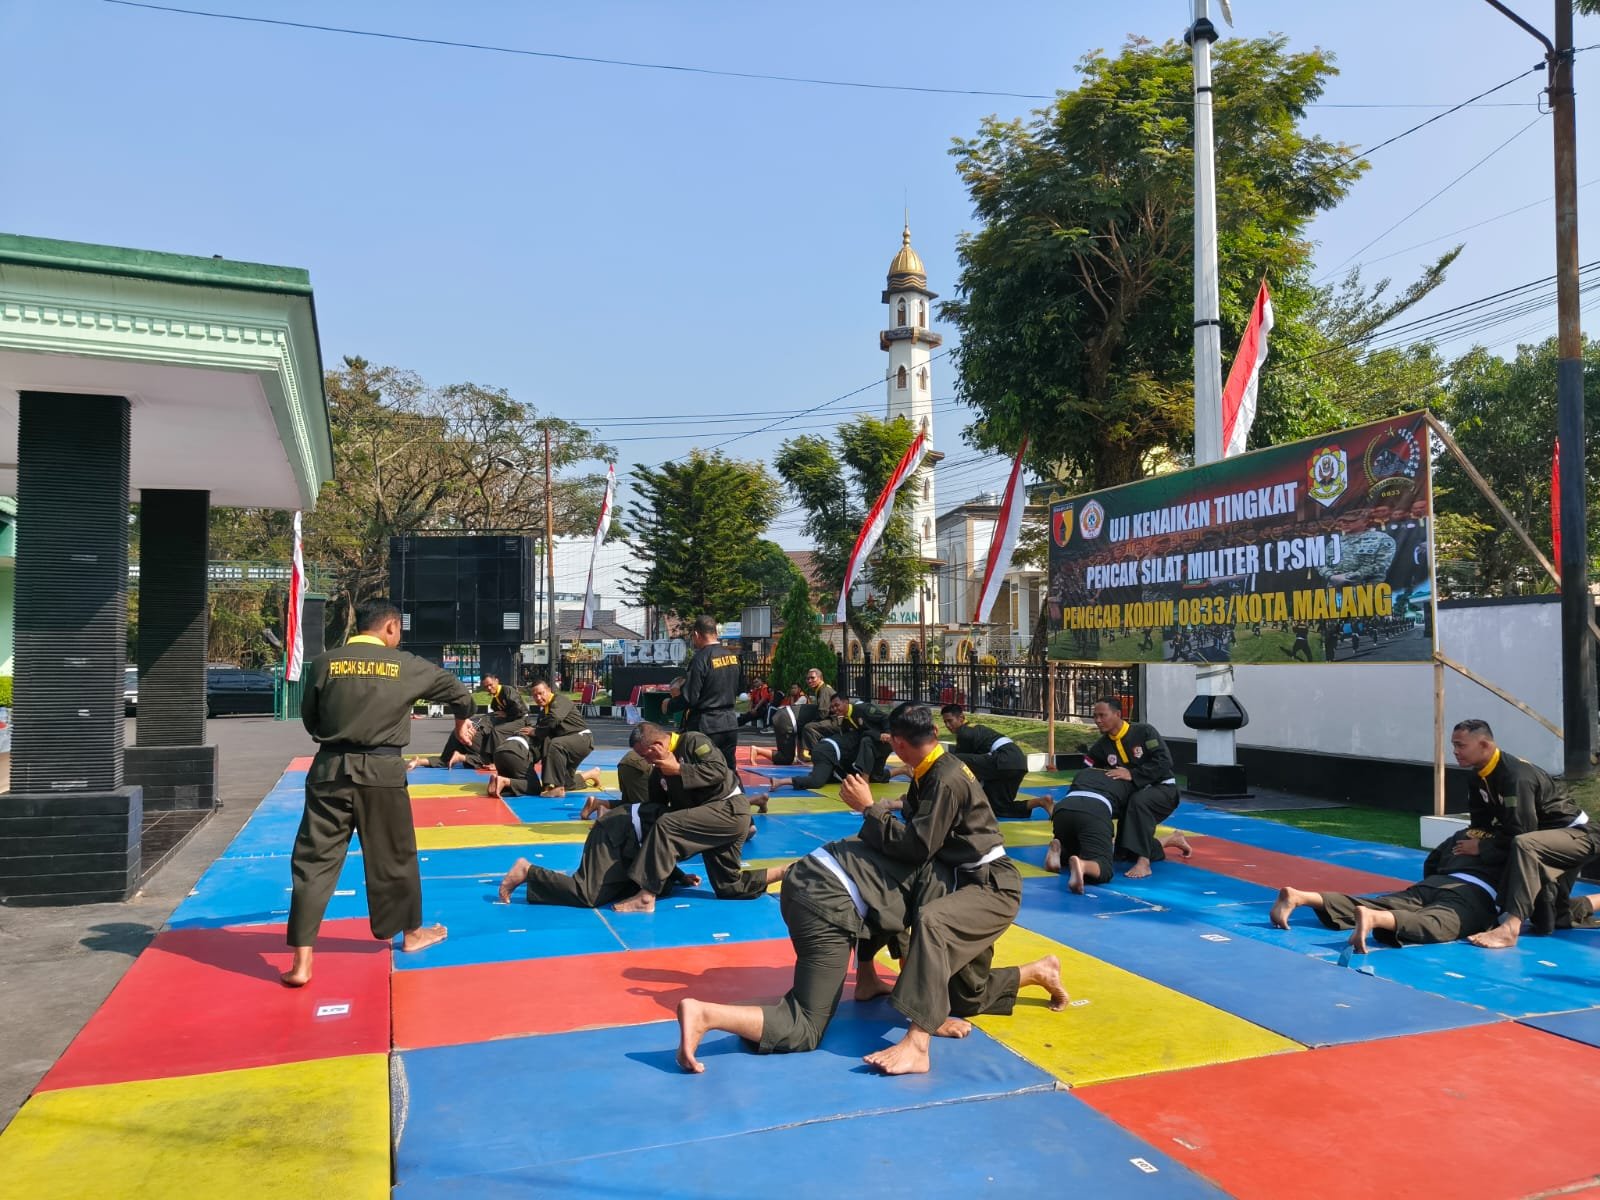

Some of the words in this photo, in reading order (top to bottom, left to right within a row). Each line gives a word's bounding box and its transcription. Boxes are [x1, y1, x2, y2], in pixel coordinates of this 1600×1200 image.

[1109, 517, 1130, 542] UJI
[1133, 500, 1210, 538] KENAIKAN
[1214, 482, 1298, 524] TINGKAT
[1086, 561, 1139, 589] PENCAK
[1141, 555, 1185, 585] SILAT
[1187, 545, 1260, 581] MILITER
[1124, 600, 1174, 628] KODIM
[1178, 592, 1288, 626] 0833/KOTA
[1293, 582, 1393, 620] MALANG
[329, 660, 357, 675] PENCAK
[375, 662, 400, 677] MILITER
